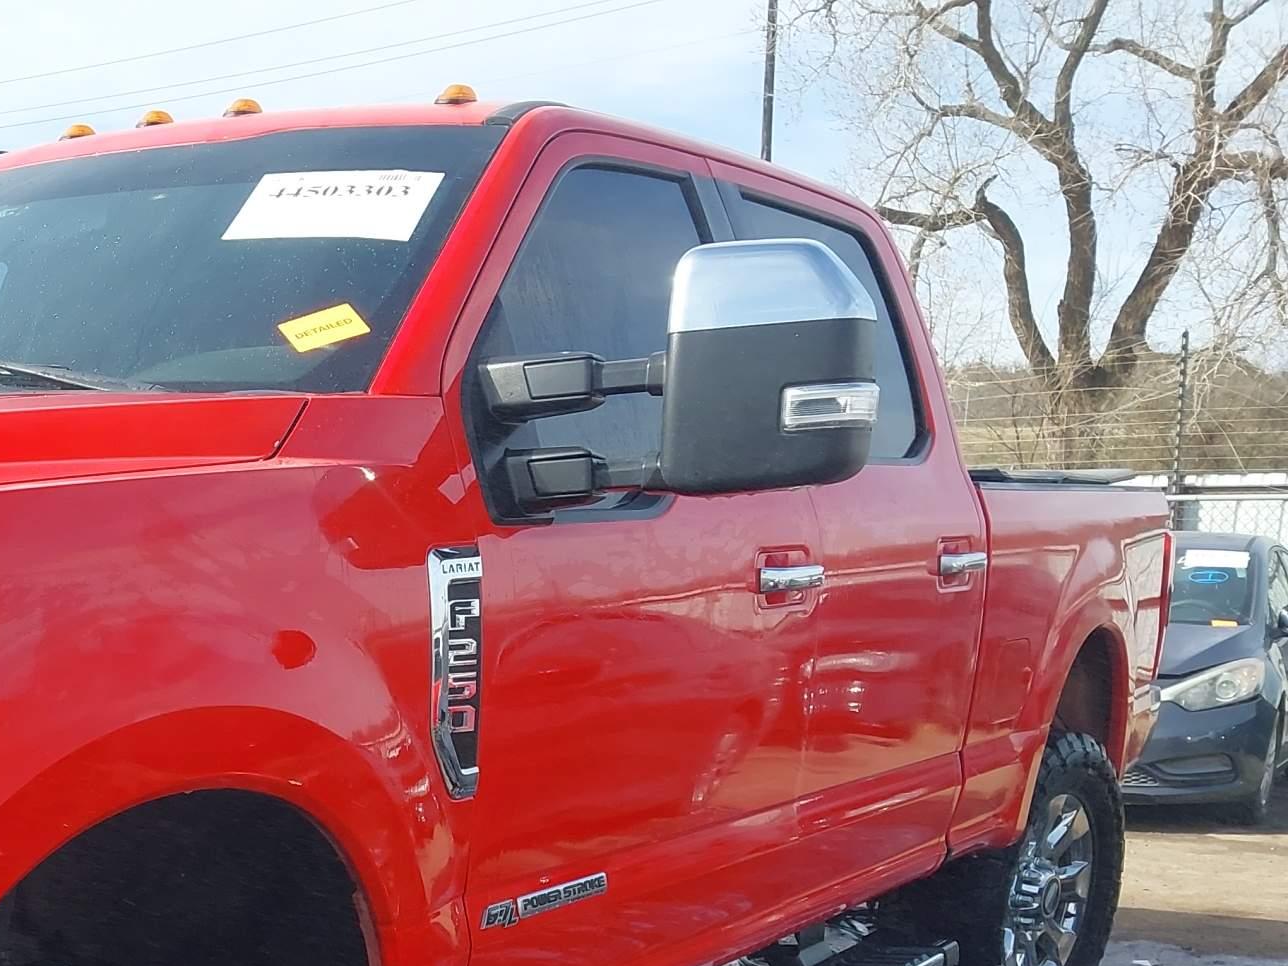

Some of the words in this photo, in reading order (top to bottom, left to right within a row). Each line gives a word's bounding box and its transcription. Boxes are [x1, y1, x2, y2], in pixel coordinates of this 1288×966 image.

[269, 185, 411, 198] 44503303
[295, 318, 353, 339] DETAILED
[441, 561, 481, 574] LARIAT
[523, 889, 561, 910] POWER
[563, 877, 605, 898] STROKE
